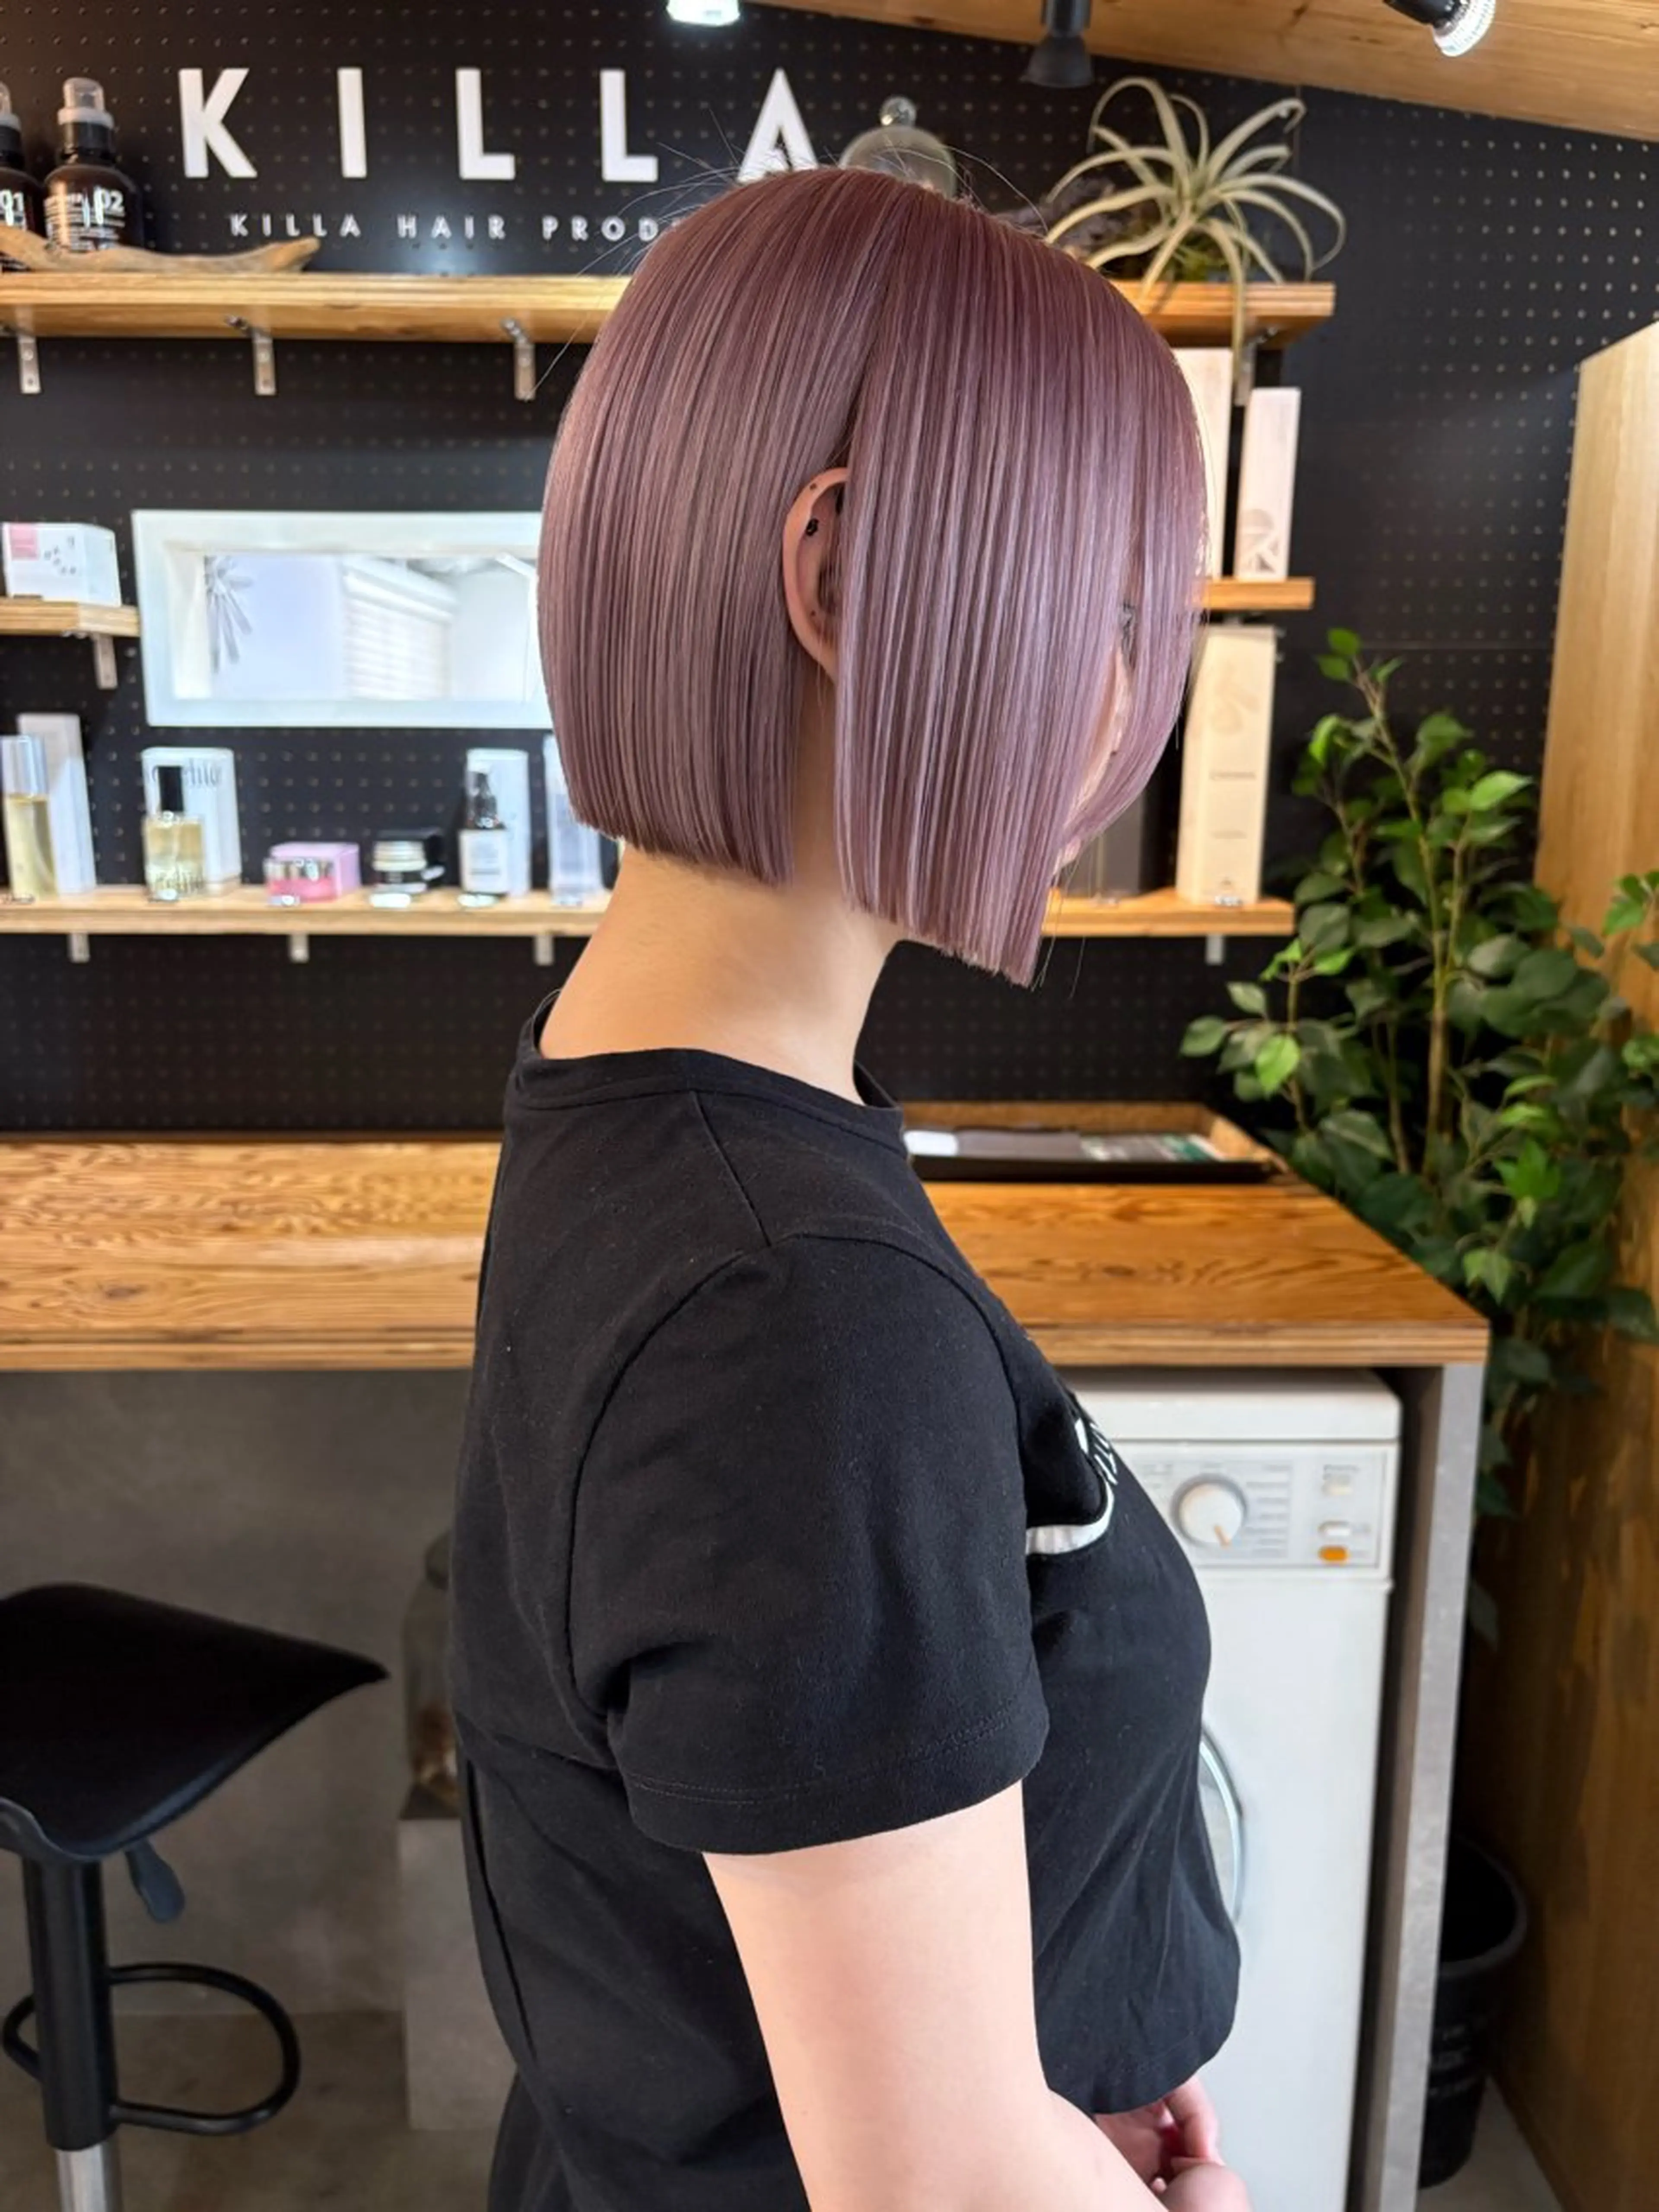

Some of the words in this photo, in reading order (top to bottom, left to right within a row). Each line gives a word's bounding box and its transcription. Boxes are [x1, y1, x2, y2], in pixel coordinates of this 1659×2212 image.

[178, 67, 819, 182] KILLA
[230, 214, 361, 237] KILLA
[397, 214, 506, 240] HAIR
[542, 216, 680, 242] PROD
